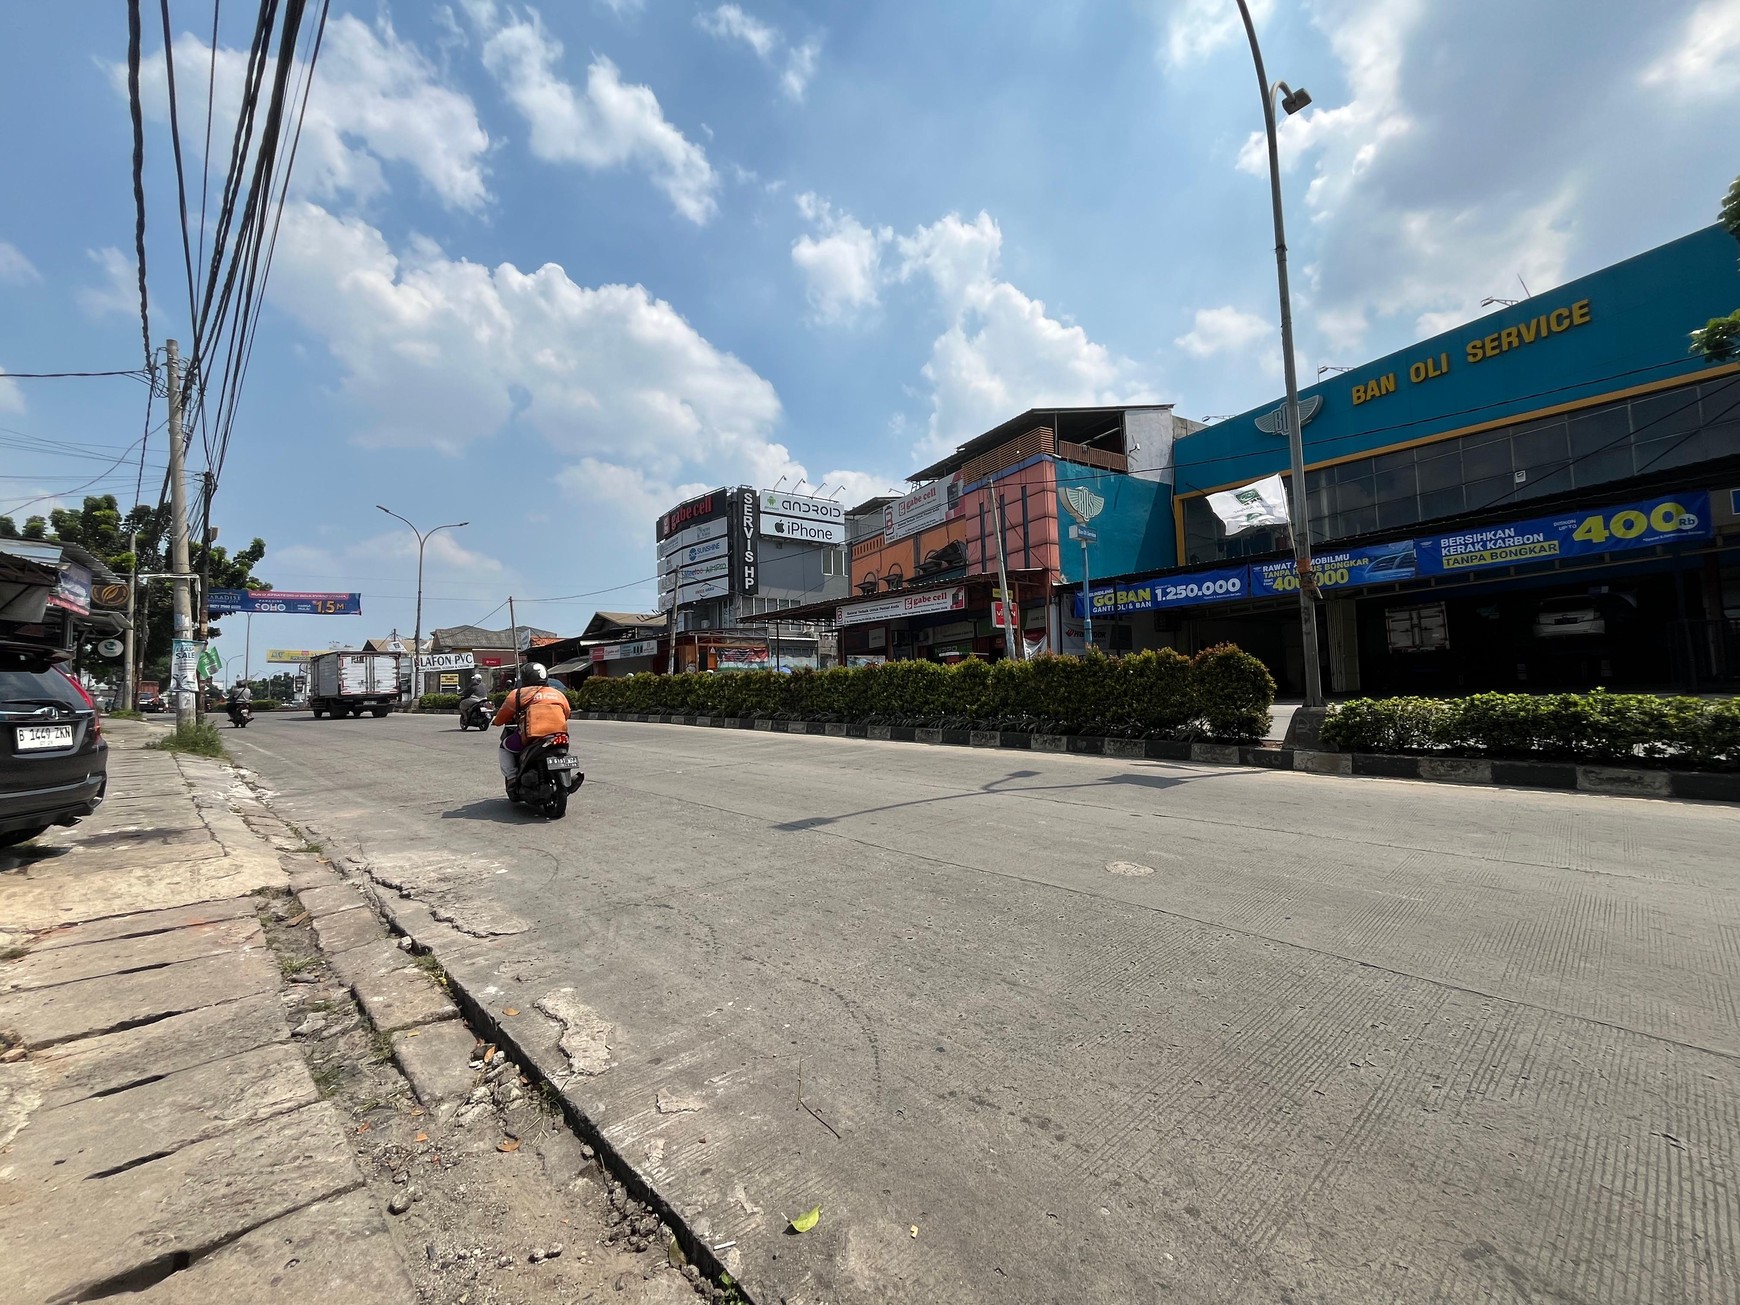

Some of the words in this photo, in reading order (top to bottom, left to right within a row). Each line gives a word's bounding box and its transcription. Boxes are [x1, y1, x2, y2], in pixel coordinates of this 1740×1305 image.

[1352, 372, 1396, 406] BAN
[1409, 352, 1449, 384] OLI
[1466, 298, 1593, 364] SERVICE
[906, 496, 922, 510] gabe
[923, 486, 936, 500] cell
[1079, 489, 1094, 519] BOS
[671, 507, 692, 530] gabe
[693, 496, 713, 517] cell
[1572, 502, 1687, 543] 400
[1679, 516, 1696, 527] Rb
[787, 521, 833, 540] iPhone
[1440, 527, 1515, 548] BERSIHKAN
[1441, 540, 1484, 556] KERAK
[1485, 532, 1544, 552] KARBON
[1444, 551, 1487, 567] TANPA
[1490, 542, 1558, 561] BONGKAR
[744, 566, 755, 590] HP
[1262, 562, 1292, 573] RAWAT
[1263, 567, 1291, 578] TANPA
[1324, 557, 1369, 571] BONGKAR
[913, 596, 931, 605] gabe
[932, 592, 947, 601] cell
[1117, 587, 1151, 603] BAN
[1155, 577, 1241, 602] 1.250.000
[255, 603, 286, 611] SOHO
[314, 600, 335, 613] 1.5
[1092, 605, 1114, 613] GANTI
[1136, 600, 1151, 608] BAN
[175, 652, 195, 660] SALE
[454, 653, 473, 665] PVC
[18, 729, 25, 742] B
[29, 728, 51, 741] 1449
[54, 726, 71, 739] ZKN
